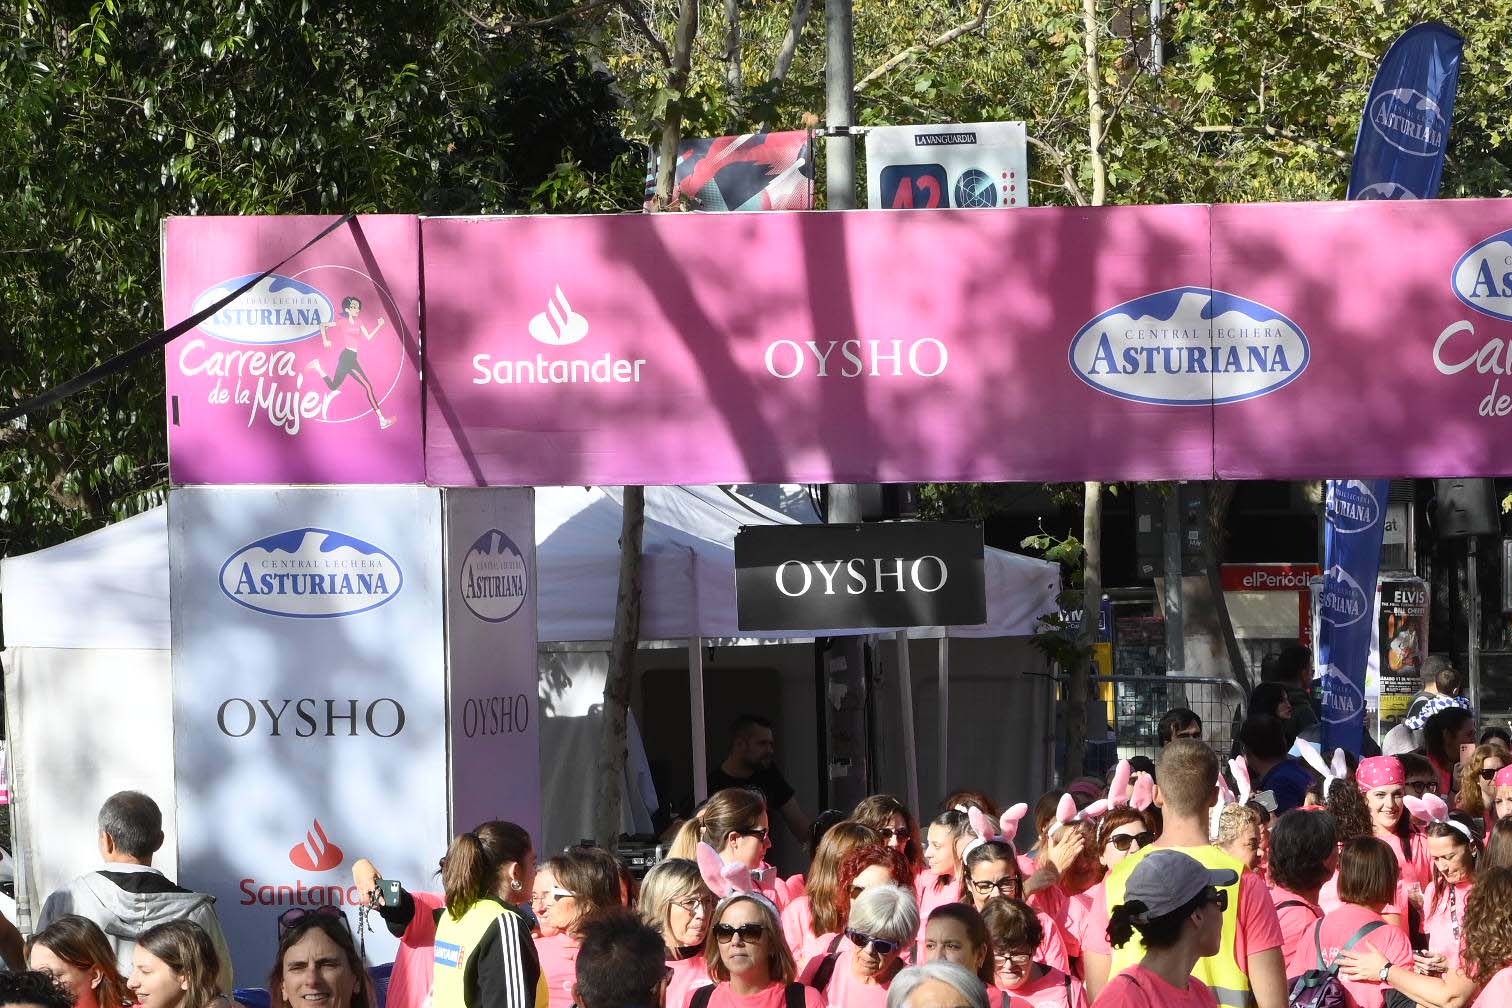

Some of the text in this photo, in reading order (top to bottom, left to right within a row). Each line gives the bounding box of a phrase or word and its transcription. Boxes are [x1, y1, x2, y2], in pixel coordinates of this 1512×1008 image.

[916, 133, 976, 145] LA VANGUARDIA
[1125, 326, 1283, 341] CENTRAL LECHERA
[179, 338, 297, 377] Carrera
[473, 353, 646, 385] Santander
[764, 337, 949, 379] OYSHO
[1088, 332, 1291, 375] ASTURIANA
[208, 373, 341, 436] de la Mujer
[1479, 378, 1512, 417] de
[234, 562, 389, 597] ASTURIANA
[262, 559, 383, 568] CENTRAL LECHERA
[466, 563, 524, 599] ASTURIANA
[775, 555, 948, 597] OYSHO
[1243, 571, 1313, 587] elPeriódi
[1394, 591, 1425, 603] ELVIS
[217, 697, 406, 738] OYSHO
[463, 694, 528, 738] OYSHO
